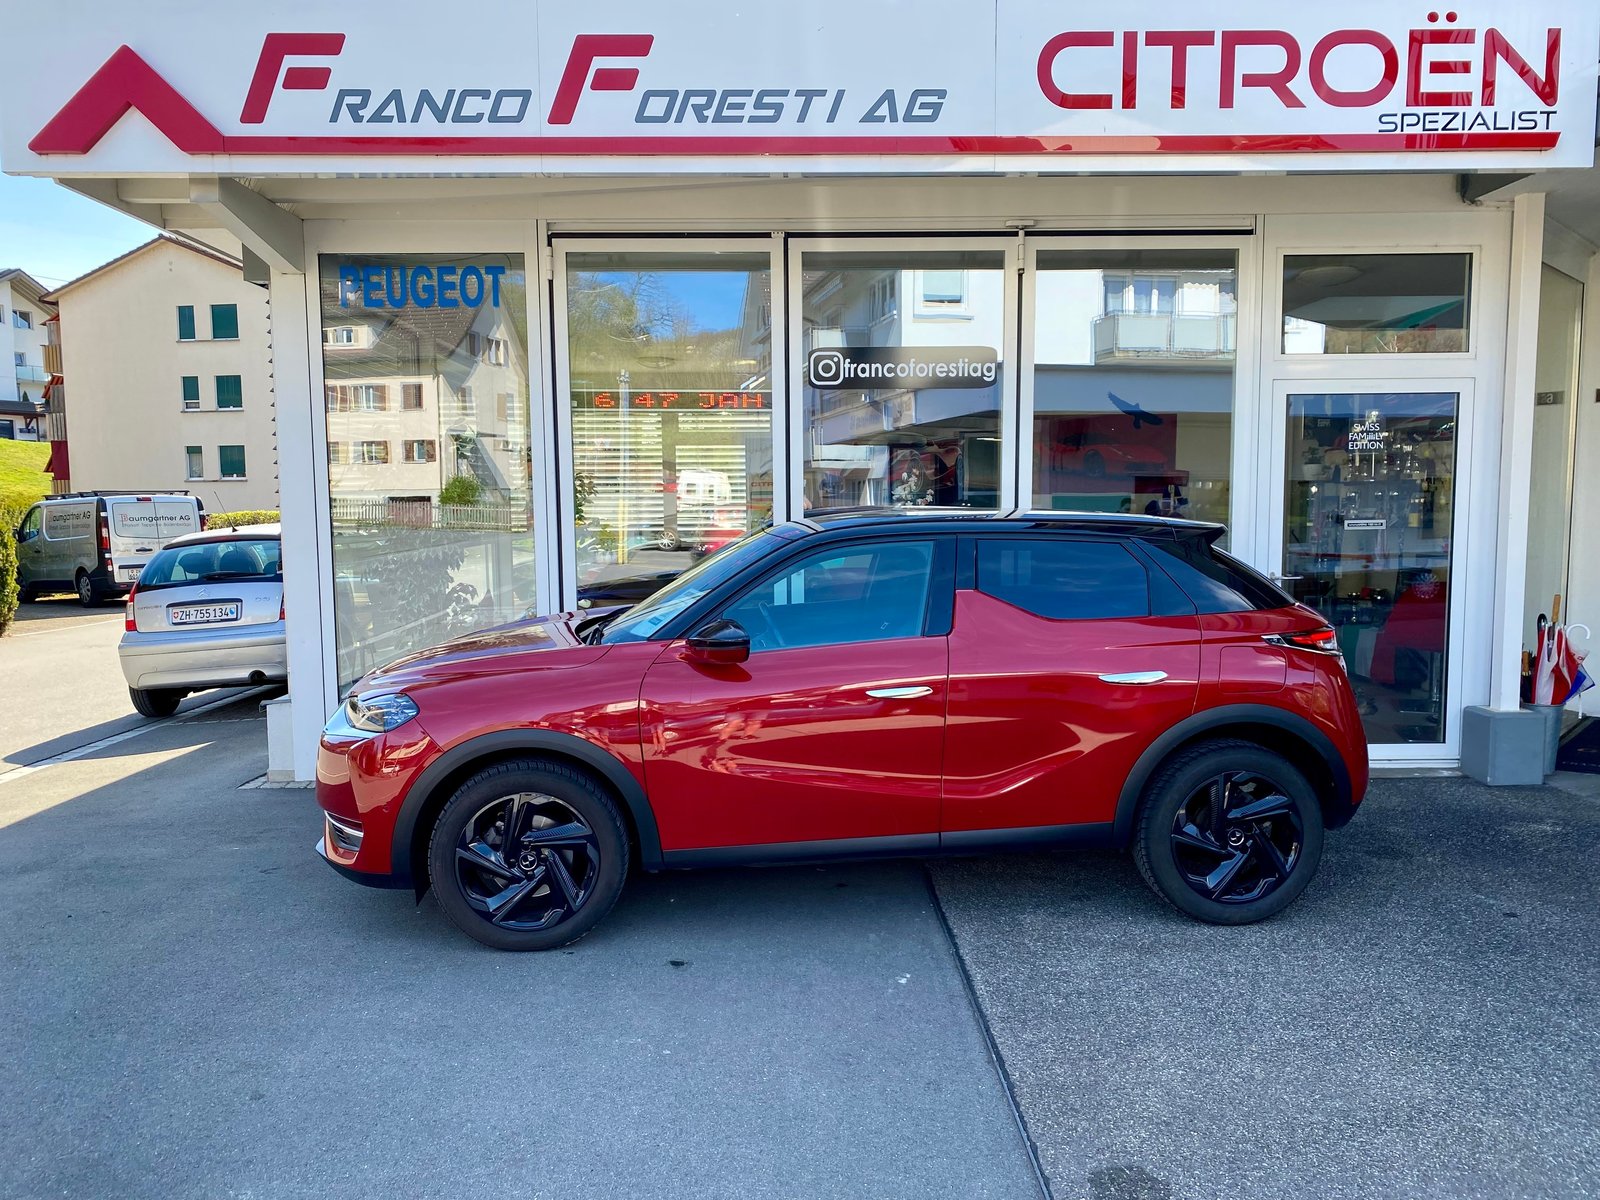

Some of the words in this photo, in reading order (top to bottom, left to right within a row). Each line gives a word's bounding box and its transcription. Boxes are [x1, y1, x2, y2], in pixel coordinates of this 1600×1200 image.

[1037, 11, 1562, 110] CITROËN
[240, 33, 532, 124] FRANCO
[548, 34, 845, 124] FORESTI
[859, 88, 948, 123] AG
[1378, 110, 1558, 133] SPEZIALIST
[338, 265, 506, 308] PEUGEOT
[844, 357, 997, 382] francoforestiag
[635, 392, 679, 408] 47
[1353, 421, 1380, 431] SWISS
[1348, 441, 1384, 450] EDITION
[82, 511, 91, 519] AG
